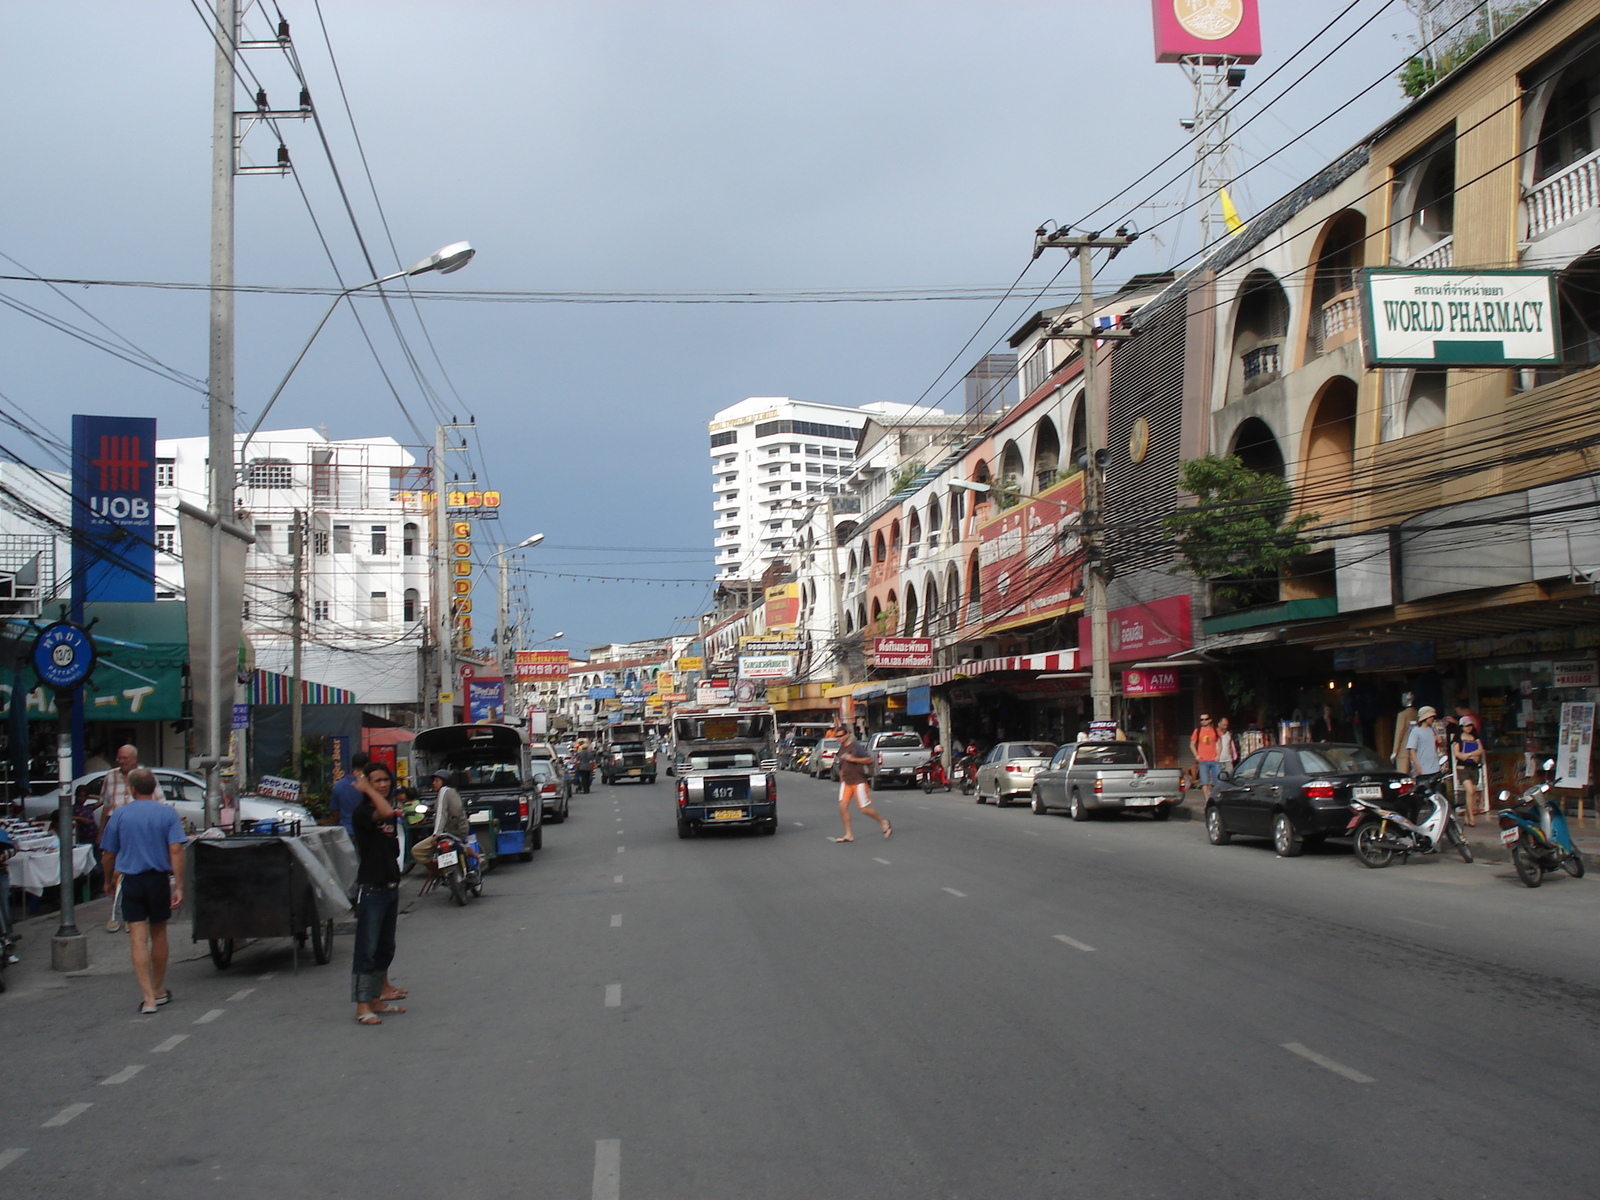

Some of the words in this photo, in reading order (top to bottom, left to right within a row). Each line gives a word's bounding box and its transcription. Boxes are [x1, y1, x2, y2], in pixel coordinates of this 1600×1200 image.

[1383, 300, 1445, 332] WORLD
[1448, 301, 1544, 332] PHARMACY
[90, 497, 150, 518] UOB
[47, 663, 80, 676] PATTAYA
[1150, 673, 1175, 685] ATM
[1561, 675, 1593, 684] MASSAGE
